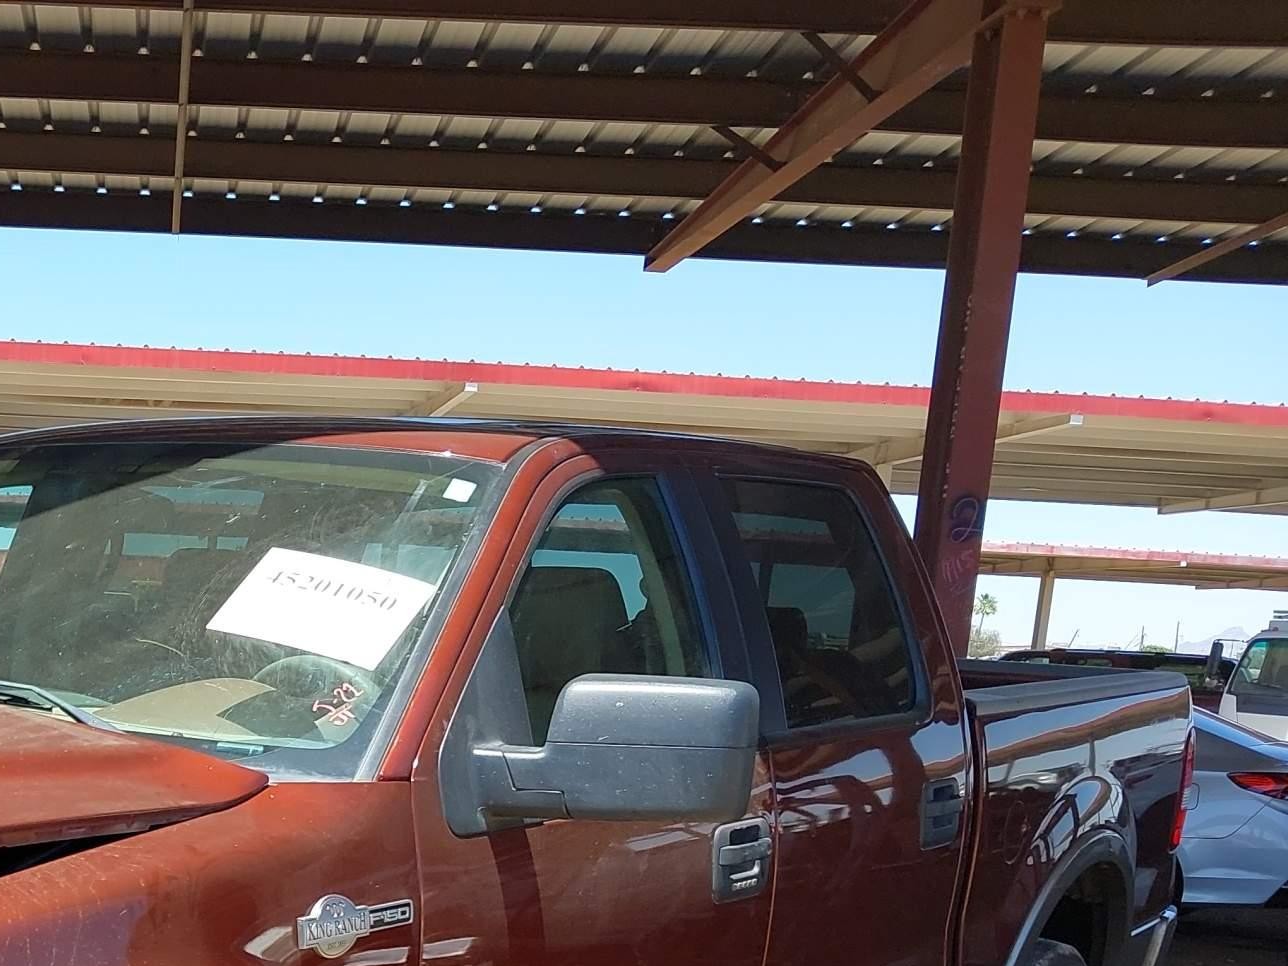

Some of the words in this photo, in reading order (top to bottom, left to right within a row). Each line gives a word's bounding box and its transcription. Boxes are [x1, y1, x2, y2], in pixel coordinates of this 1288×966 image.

[266, 569, 398, 612] 45201050
[307, 921, 333, 941] KING
[334, 911, 367, 936] RANCH
